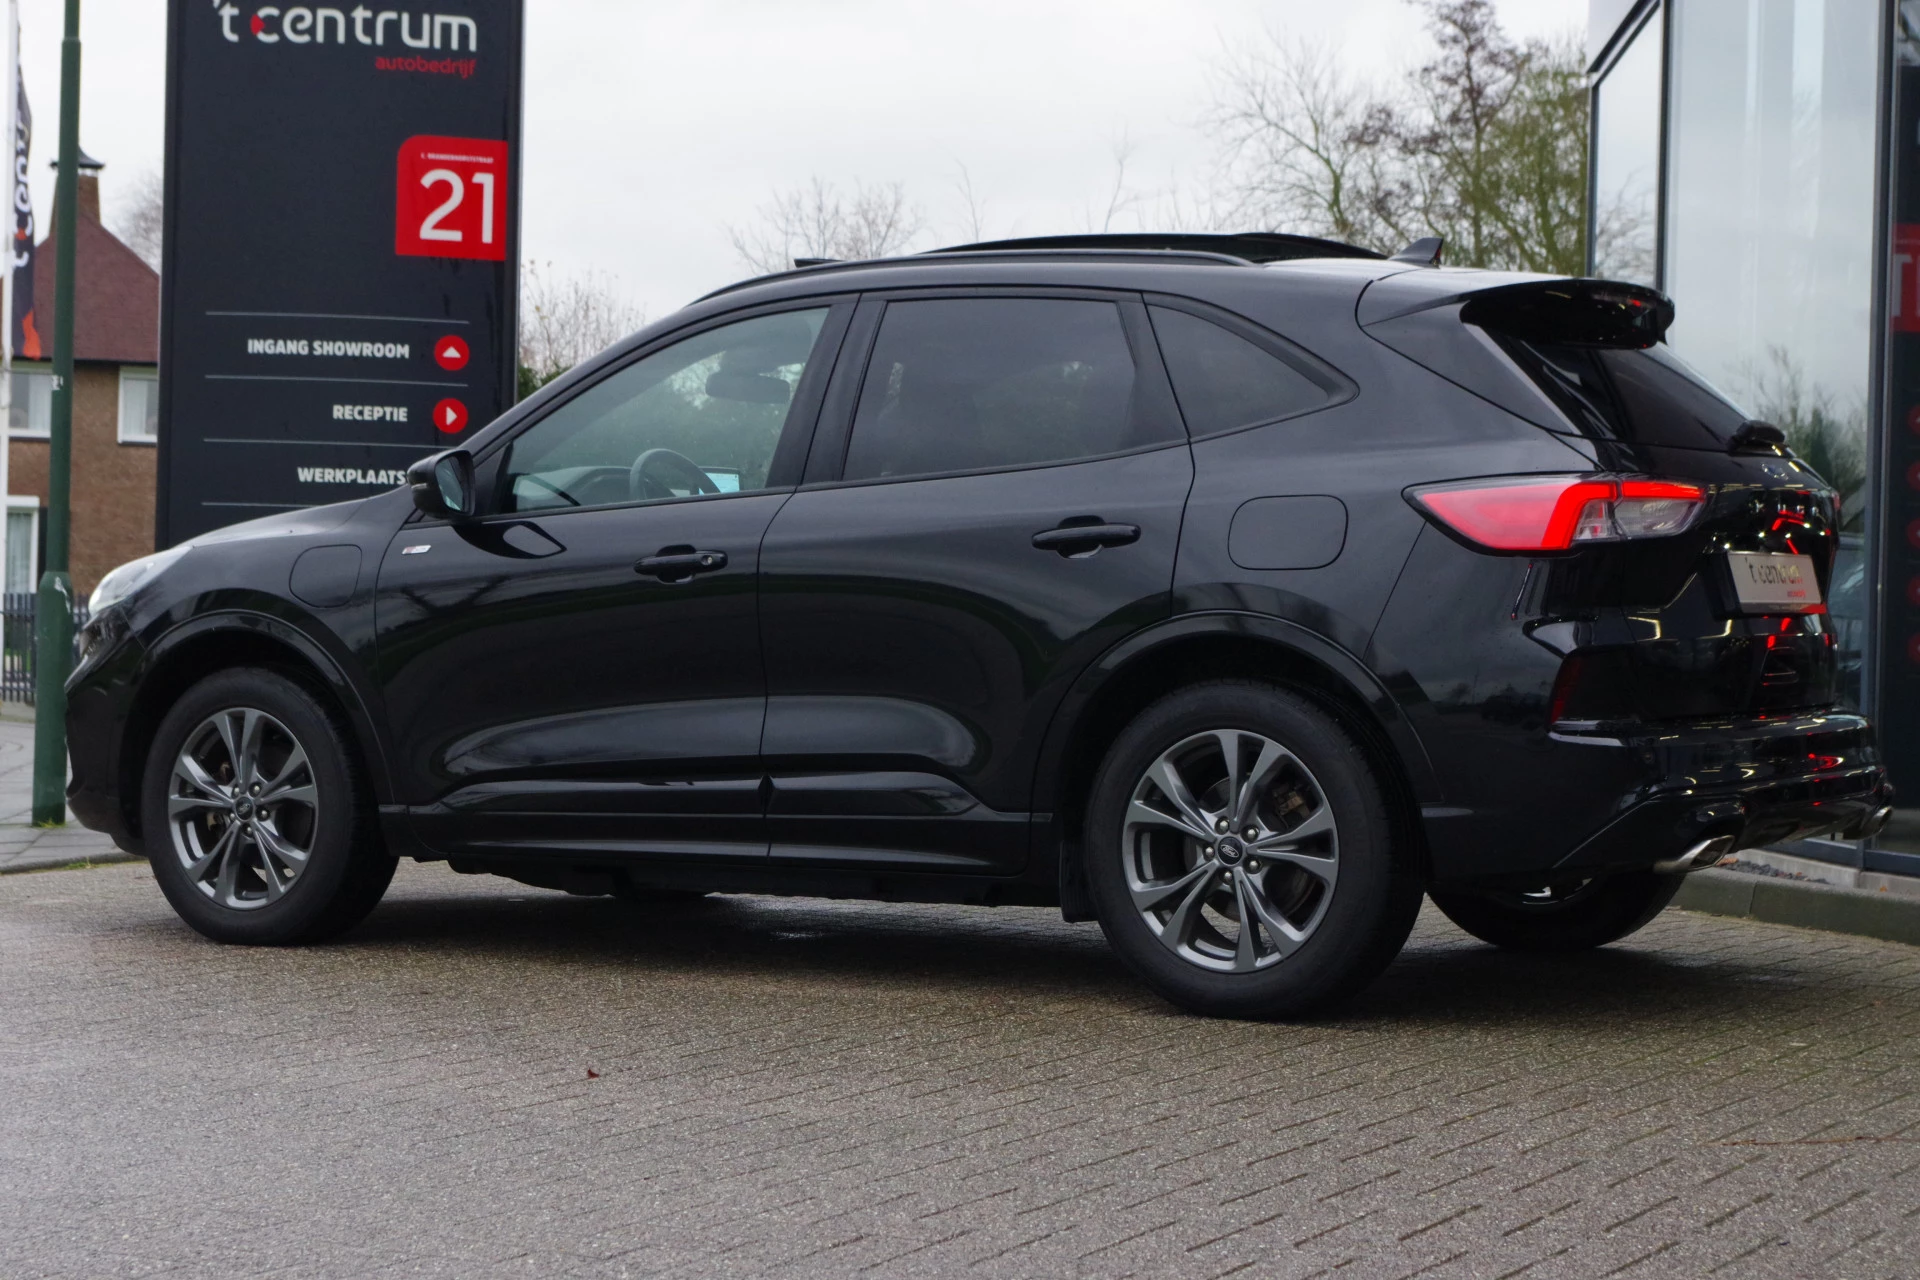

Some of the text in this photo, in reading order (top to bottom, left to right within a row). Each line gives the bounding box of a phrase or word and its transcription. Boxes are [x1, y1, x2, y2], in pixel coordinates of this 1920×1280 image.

[251, 4, 477, 52] centrum
[375, 56, 476, 78] autobedrijf
[419, 168, 495, 244] 21
[247, 338, 410, 359] INGANG SHOWROOM
[332, 404, 408, 422] RECEPTIE
[297, 467, 406, 485] WERKPLAATS
